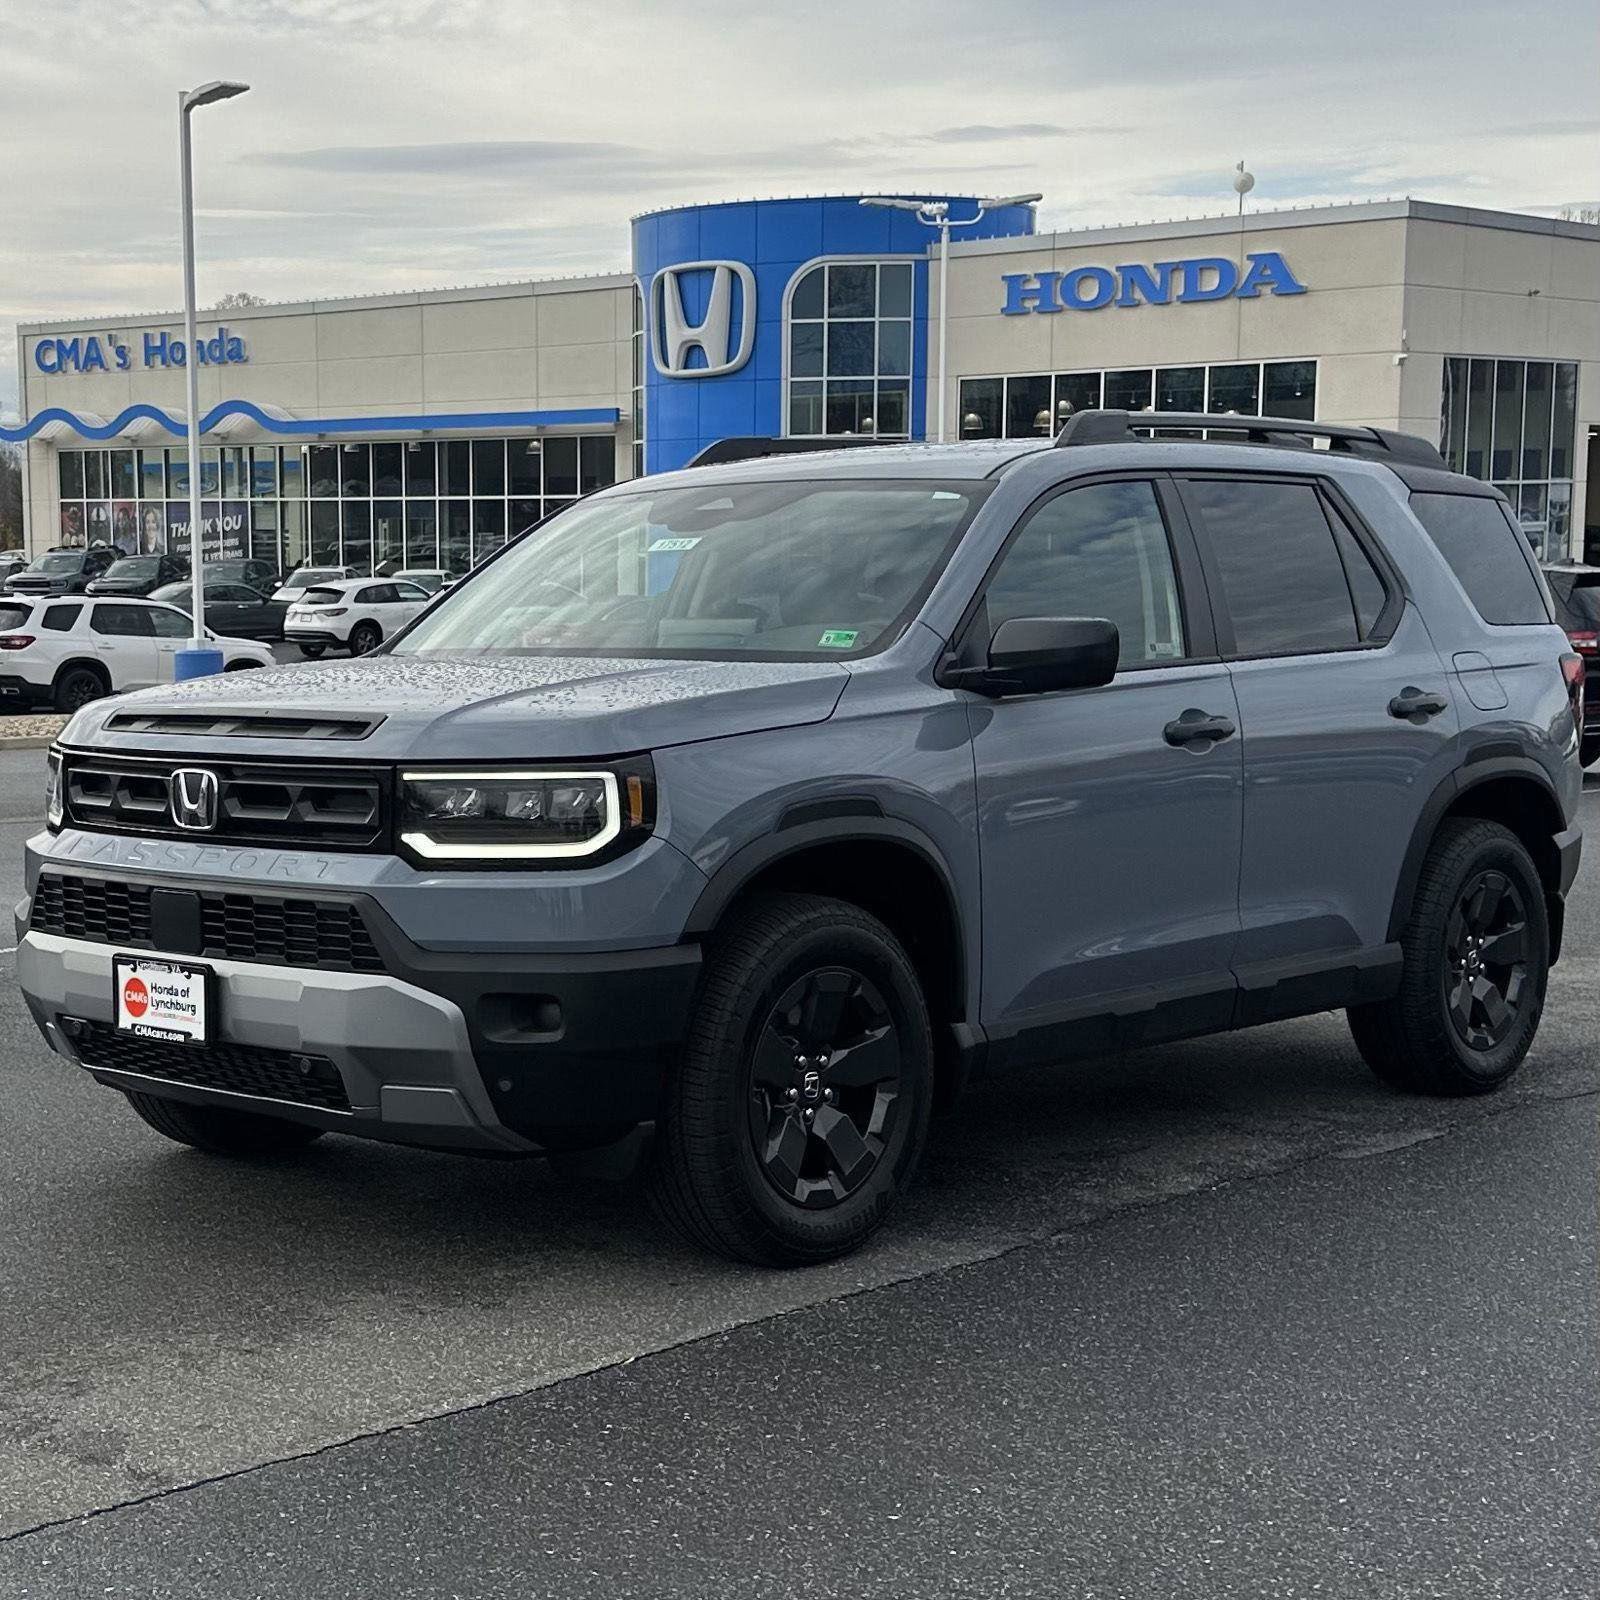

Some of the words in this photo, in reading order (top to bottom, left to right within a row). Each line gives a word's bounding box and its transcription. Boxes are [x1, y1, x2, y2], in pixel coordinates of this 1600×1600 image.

[1000, 251, 1308, 316] HONDA
[35, 333, 131, 374] CMA's
[215, 514, 242, 532] YOU
[67, 836, 348, 880] PASSPORT
[150, 982, 179, 997] Honda
[180, 987, 190, 998] of
[151, 996, 197, 1017] Lynchburg
[134, 1024, 185, 1043] CMAcars.com
